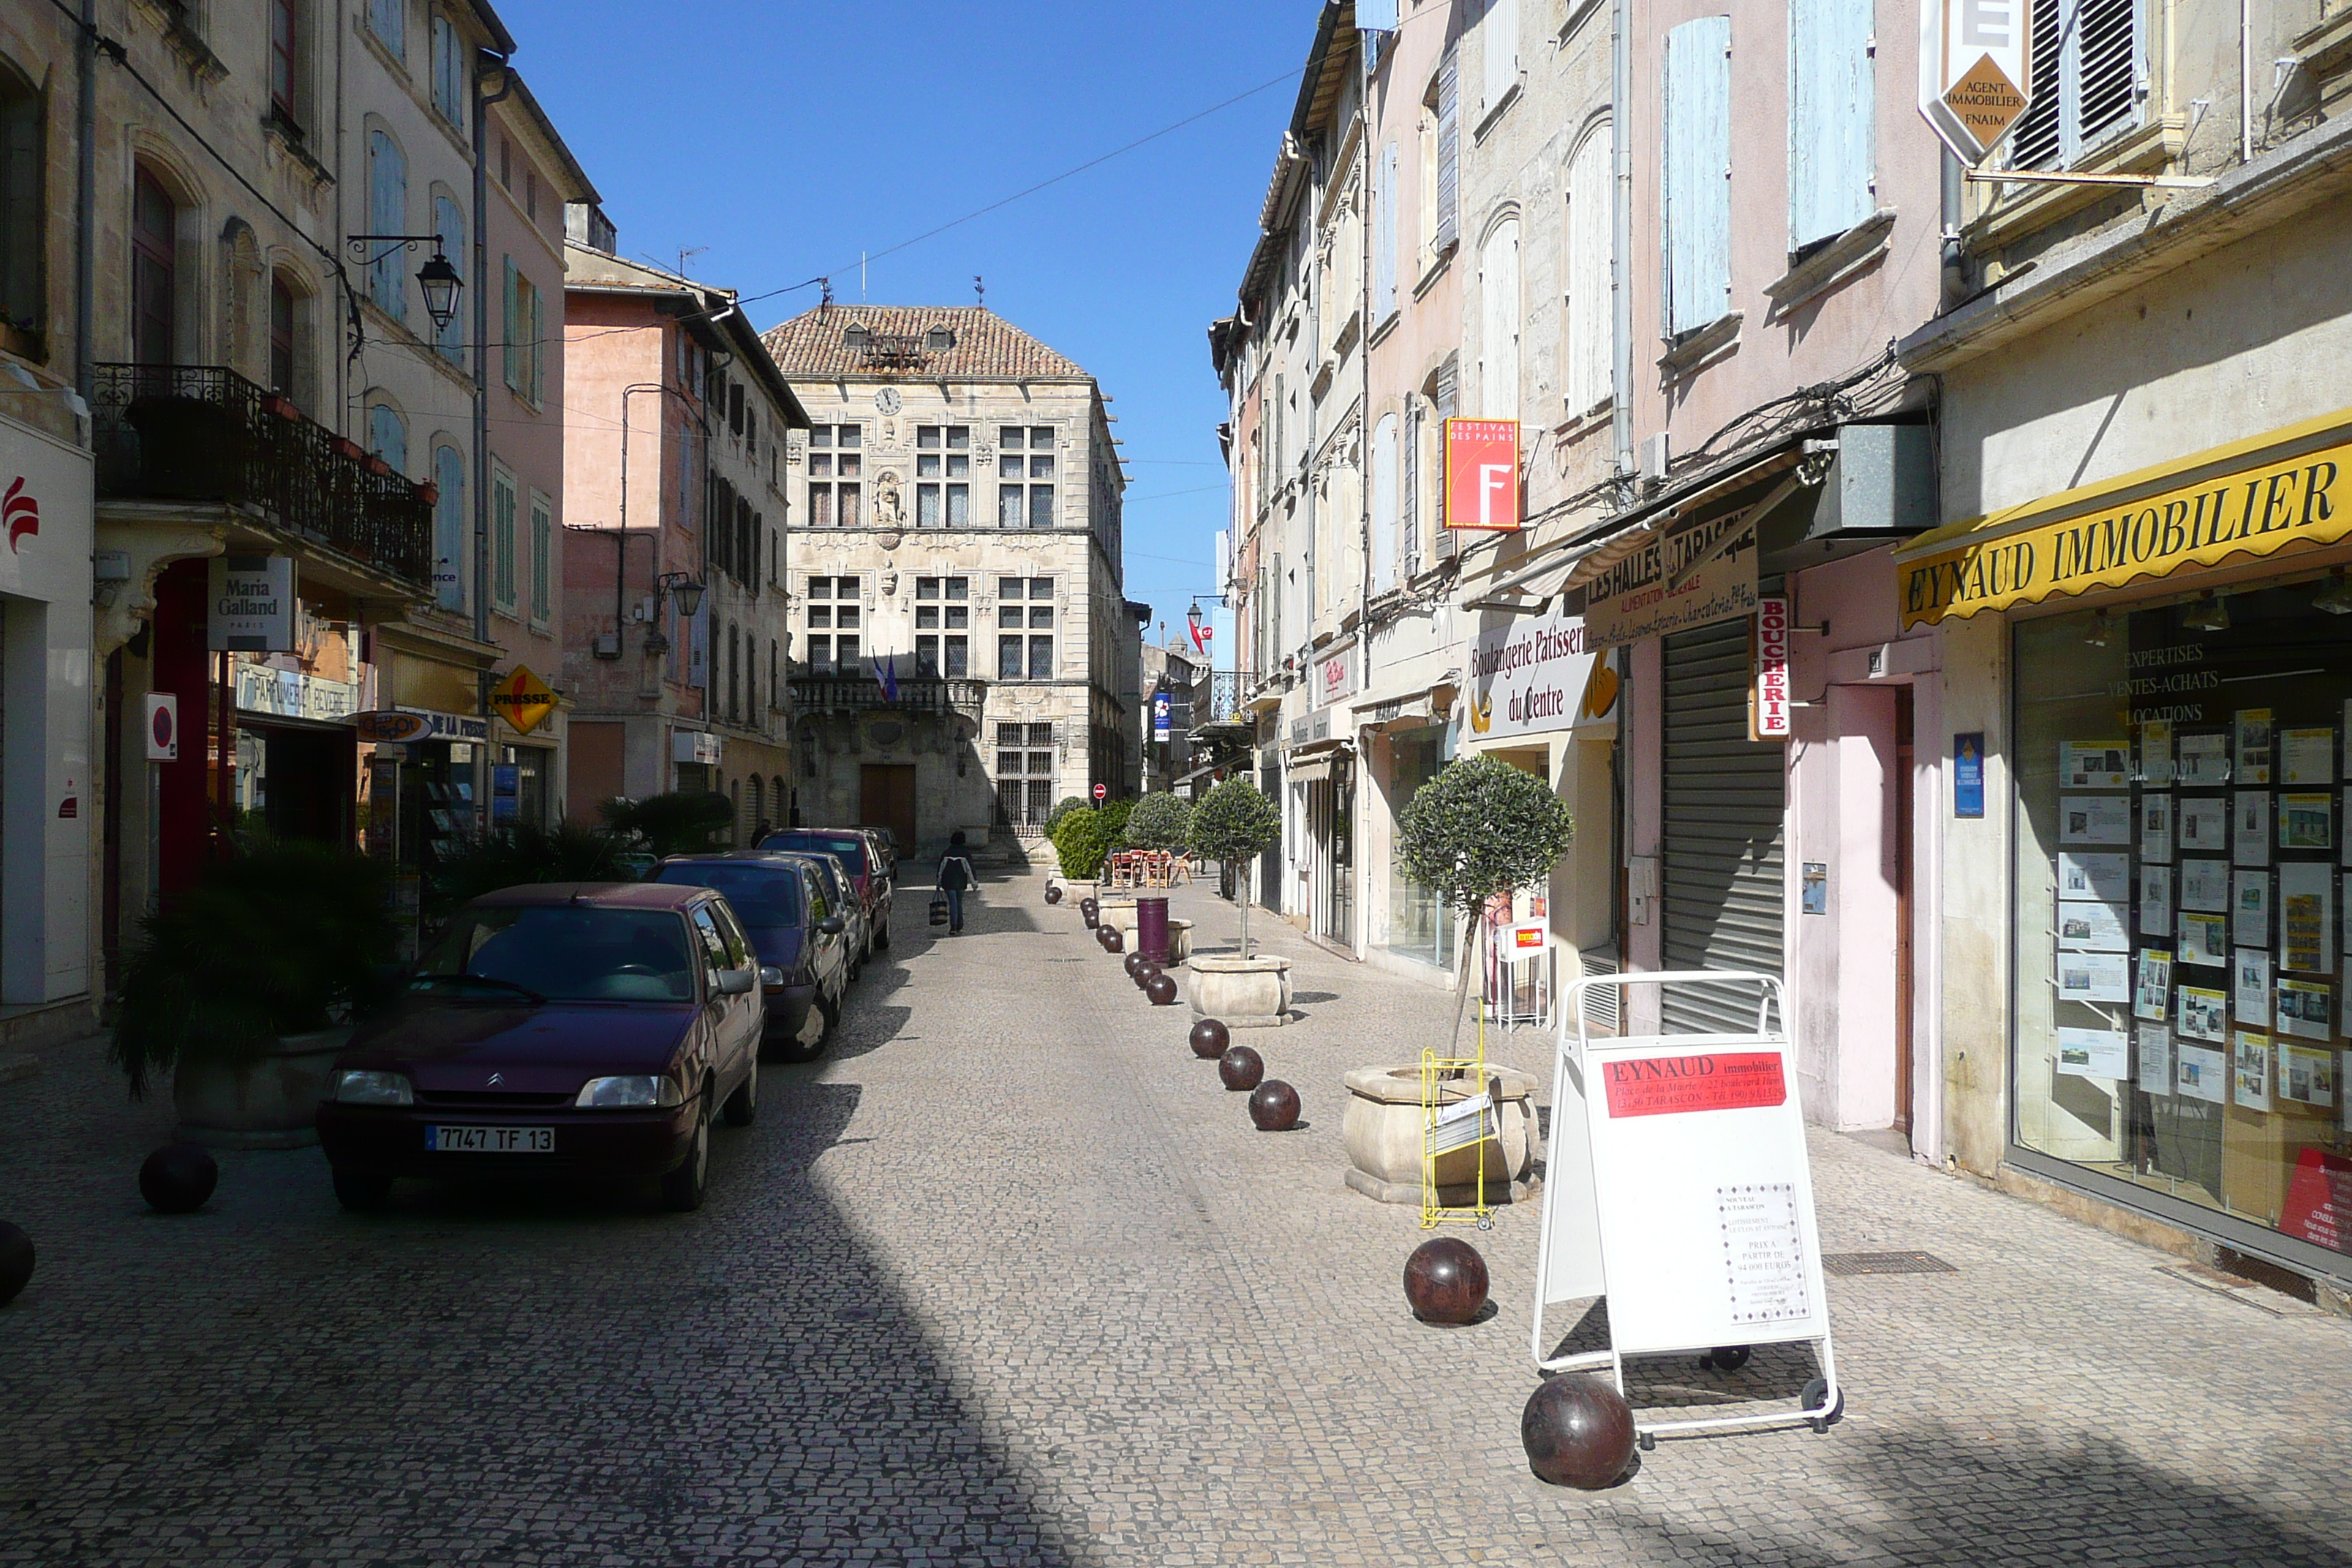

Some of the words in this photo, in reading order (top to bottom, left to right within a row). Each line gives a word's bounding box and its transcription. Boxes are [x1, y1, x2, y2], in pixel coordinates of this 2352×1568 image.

[1965, 82, 2006, 94] AGENT
[1948, 94, 2022, 108] IMMOBILIER
[1966, 114, 2005, 126] FNAIM
[1450, 422, 1513, 431] FESTIVAL
[1476, 434, 1513, 442] PAINS
[1480, 464, 1512, 524] F
[1906, 541, 2035, 614] EYNAUD
[2049, 461, 2338, 583] IMMOBILIER
[1588, 570, 1610, 606] LES
[1613, 546, 1662, 596] HALLES
[225, 578, 270, 596] Maria
[218, 598, 278, 616] Galland
[1621, 588, 1664, 614] ALIMENTATION
[1472, 633, 1533, 680] Boulangerie
[2124, 643, 2204, 668] EXPERTISES
[1761, 601, 1786, 730] BOUCHERIE
[2108, 671, 2219, 698] VENTES-ACHATS
[494, 693, 551, 705] PRESSE
[1509, 689, 1523, 722] du
[1525, 683, 1564, 720] Centre
[2126, 704, 2203, 725] LOCATIONS
[447, 716, 457, 736] LA
[1613, 1057, 1715, 1082] EYNAUD
[1724, 1061, 1778, 1074] immobilier
[1616, 1086, 1639, 1096] Place
[1643, 1084, 1654, 1094] de
[1657, 1083, 1665, 1093] la
[1668, 1081, 1697, 1092] Mairie
[1708, 1079, 1718, 1089] 22
[1721, 1077, 1760, 1088] boulevard
[1617, 1098, 1643, 1108] 13150
[1647, 1093, 1702, 1106] TARASCON
[440, 1128, 487, 1148] 7747
[496, 1130, 521, 1149] TF
[528, 1130, 551, 1150] 13
[1728, 1218, 1769, 1226] LOTISSEMENT
[1749, 1241, 1768, 1249] PRIX
[1742, 1251, 1771, 1260] PARTIR
[1774, 1251, 1785, 1259] DE
[1749, 1263, 1763, 1271] 000
[1765, 1261, 1792, 1270] EUROS
